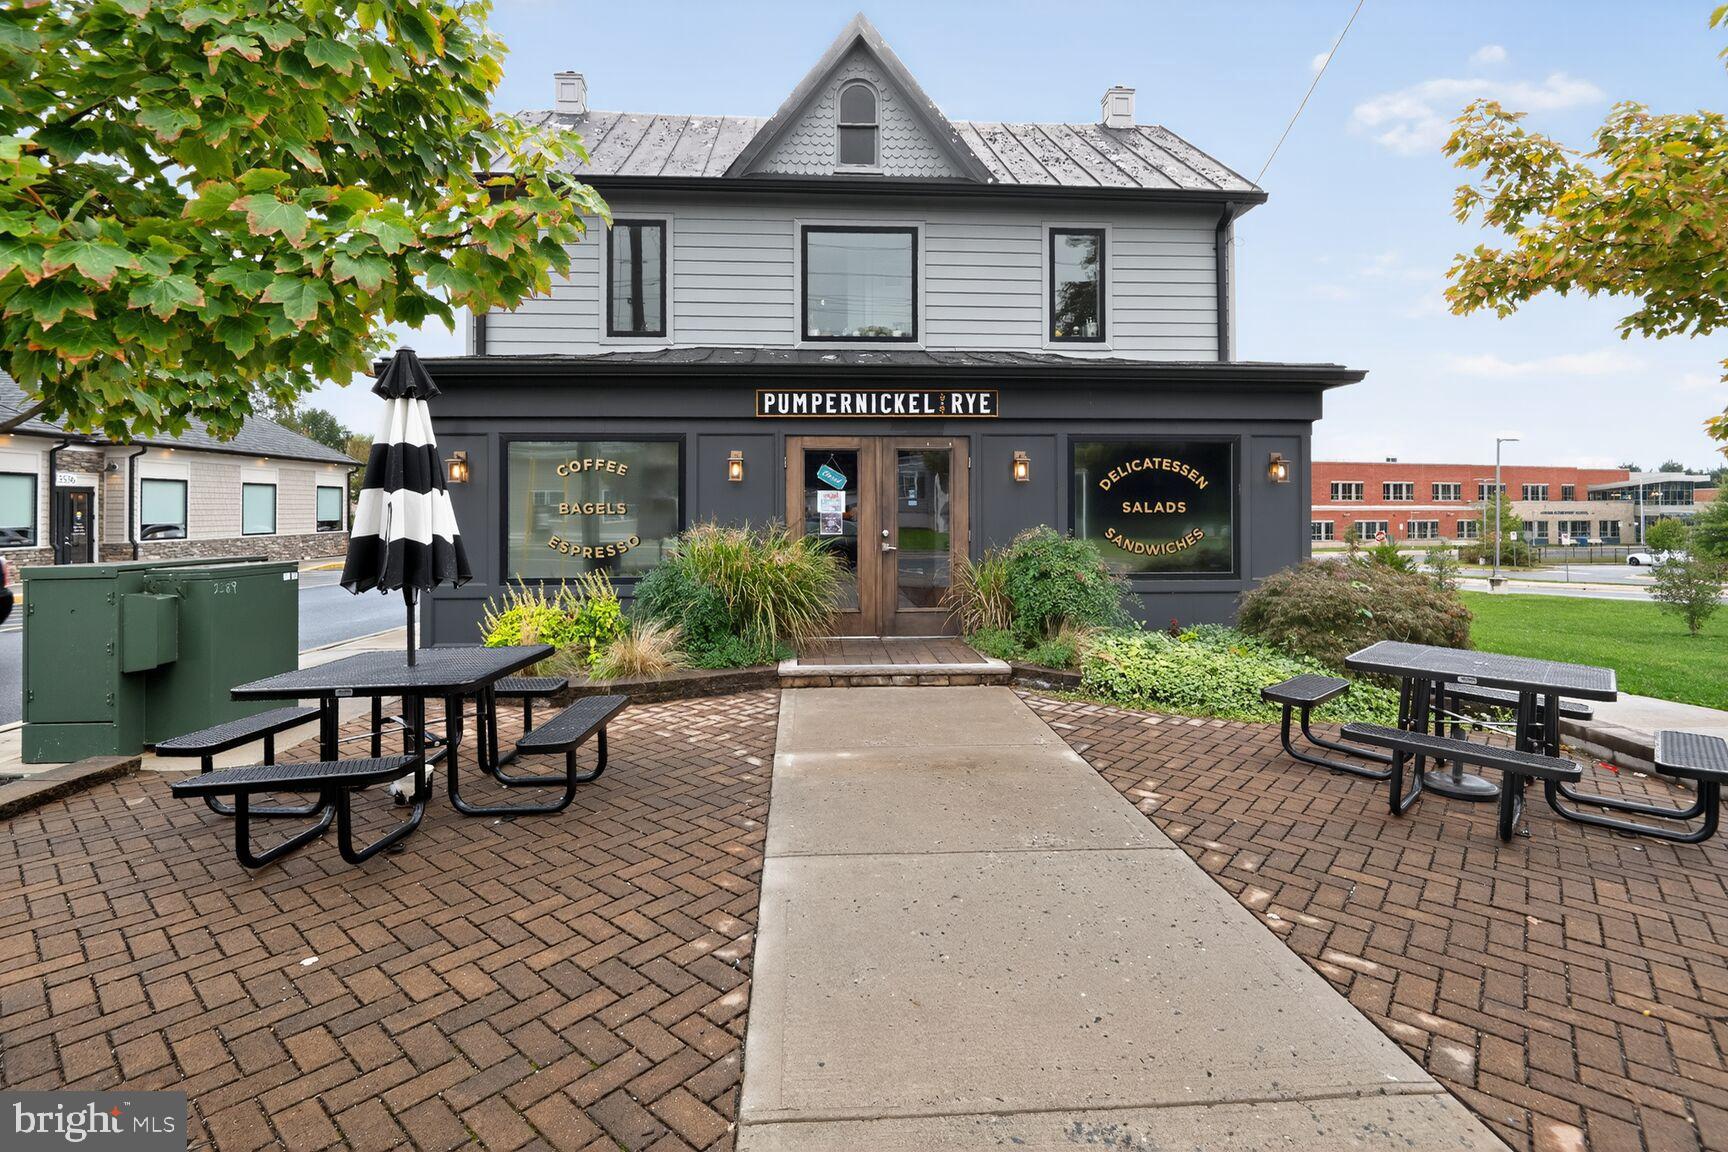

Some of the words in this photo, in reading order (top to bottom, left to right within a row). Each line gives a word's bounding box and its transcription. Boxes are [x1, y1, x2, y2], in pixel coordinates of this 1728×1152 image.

[764, 393, 935, 414] PUMPERNICKEL
[951, 393, 991, 414] RYE
[556, 458, 629, 476] COFFEE
[1099, 457, 1209, 491] DELICATESSEN
[559, 503, 628, 515] BAGELS
[1122, 501, 1187, 514] SALADS
[548, 535, 641, 559] ESPRESSO
[1104, 527, 1205, 556] SANDWICHES
